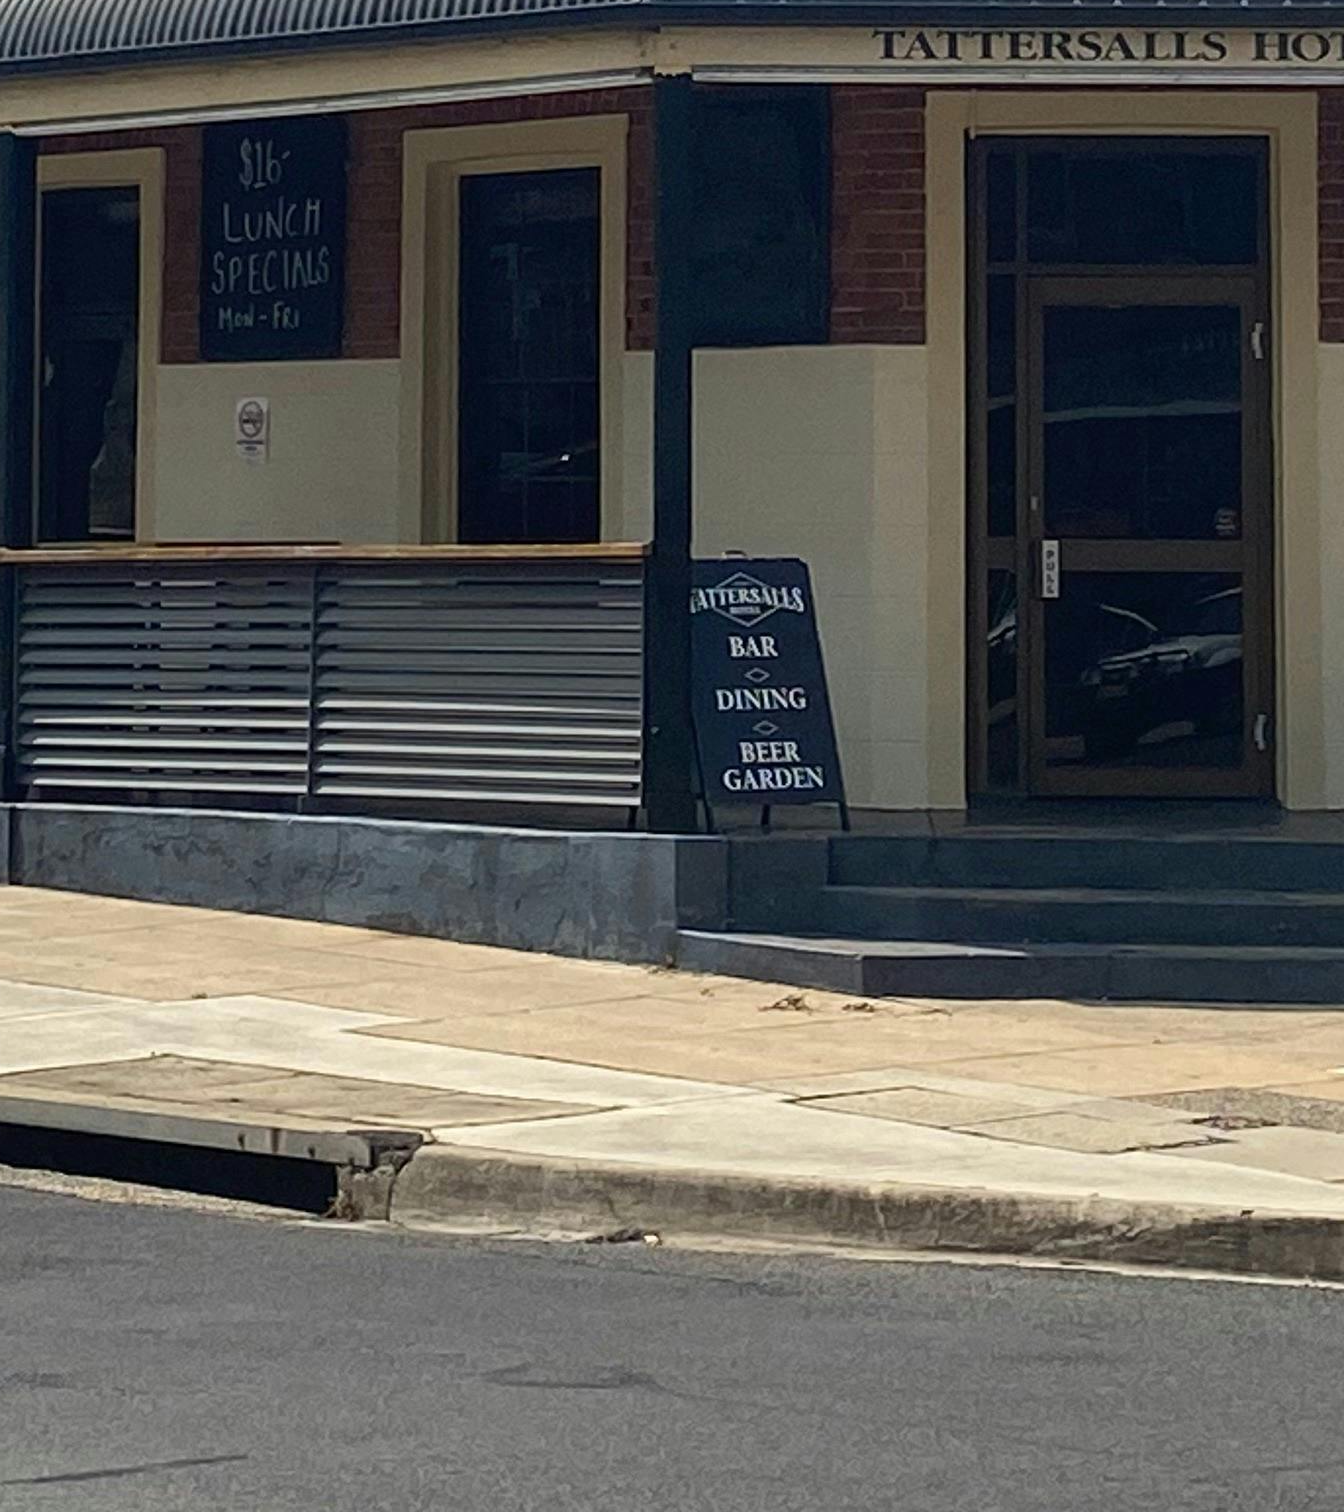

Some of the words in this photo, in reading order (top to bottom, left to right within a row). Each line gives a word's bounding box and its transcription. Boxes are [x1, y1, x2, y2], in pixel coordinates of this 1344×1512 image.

[872, 29, 1228, 61] TATTERSALLS
[223, 196, 320, 243] LUNCH
[211, 246, 330, 294] SPECIALS
[728, 636, 778, 658] BAR
[716, 687, 807, 711] DINING
[739, 741, 801, 763] BEER
[723, 766, 824, 791] GARDEN
